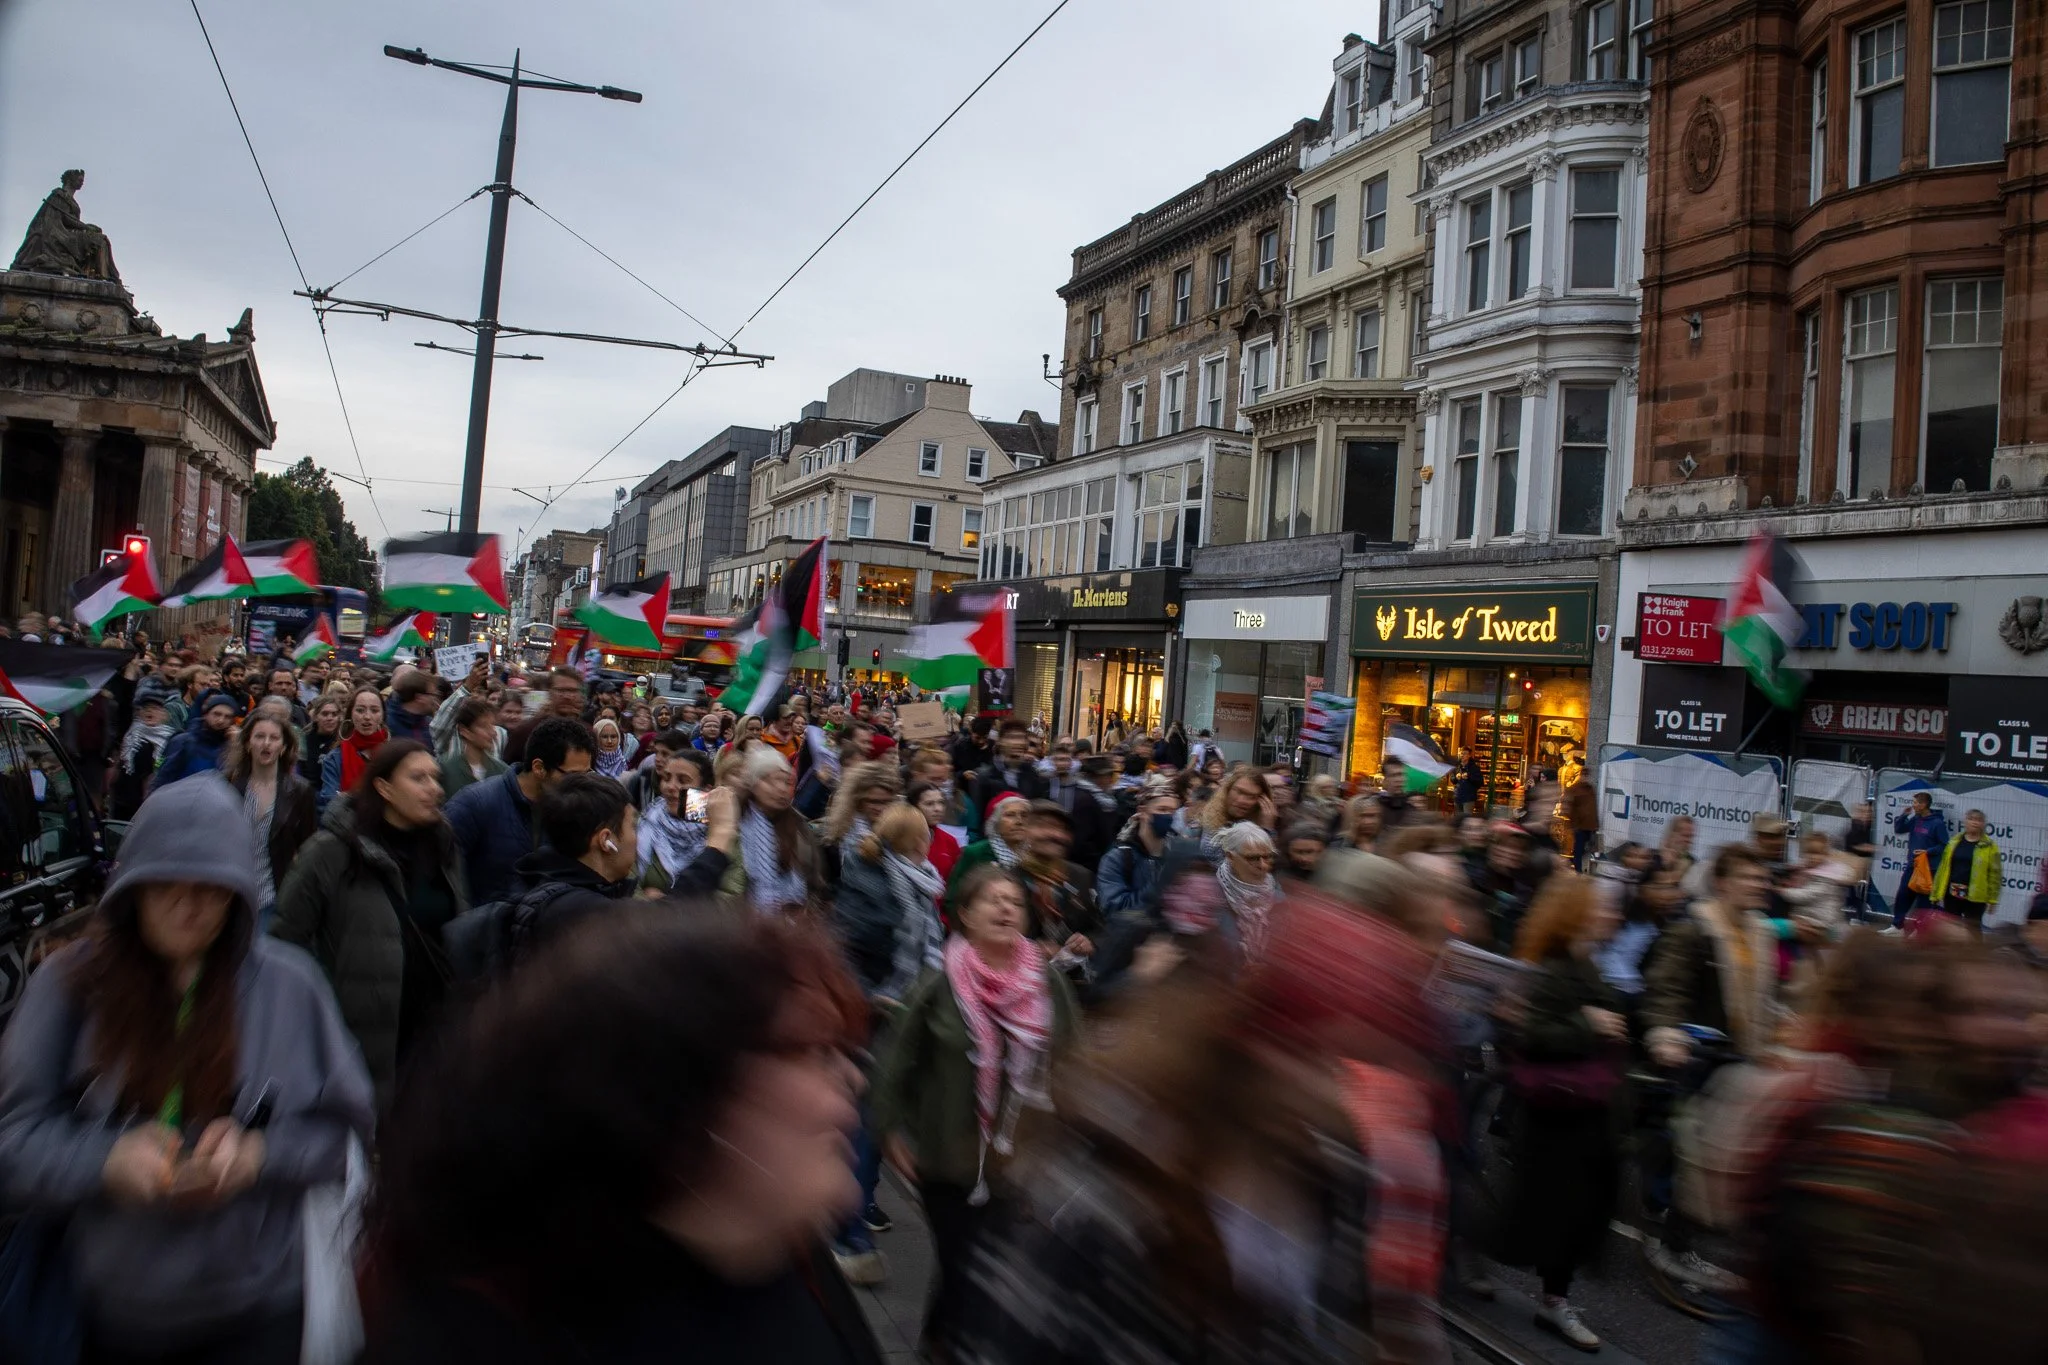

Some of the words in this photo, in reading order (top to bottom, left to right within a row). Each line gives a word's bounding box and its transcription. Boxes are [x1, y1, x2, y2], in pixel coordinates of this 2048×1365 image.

[1662, 597, 1689, 608] Knight
[1233, 610, 1263, 627] Three
[1662, 607, 1684, 616] Frank
[1403, 606, 1446, 640] Isle
[1452, 606, 1474, 640] of
[1476, 605, 1557, 642] Tweed
[1643, 618, 1672, 636] TO
[1679, 622, 1712, 639] LET
[1849, 602, 1956, 650] SCOT
[1641, 645, 1660, 654] 0131
[1661, 646, 1675, 655] 222
[1676, 648, 1694, 656] 9601
[1655, 709, 1683, 729] TO
[1688, 711, 1727, 732] LET
[1842, 705, 1900, 731] GREAT
[1903, 708, 1948, 735] SCO
[1960, 731, 2001, 756] TO
[2011, 734, 2048, 759] LE
[1976, 760, 1999, 768] PRIME
[1999, 762, 2025, 771] RETAIL
[2026, 764, 2044, 772] UNIT
[1634, 794, 1690, 816] Thomas
[1692, 801, 1761, 824] Johnston
[1632, 814, 1650, 824] Since
[1883, 835, 1909, 849] Man
[1881, 857, 1908, 872] Sma
[2001, 877, 2043, 893] ecora
